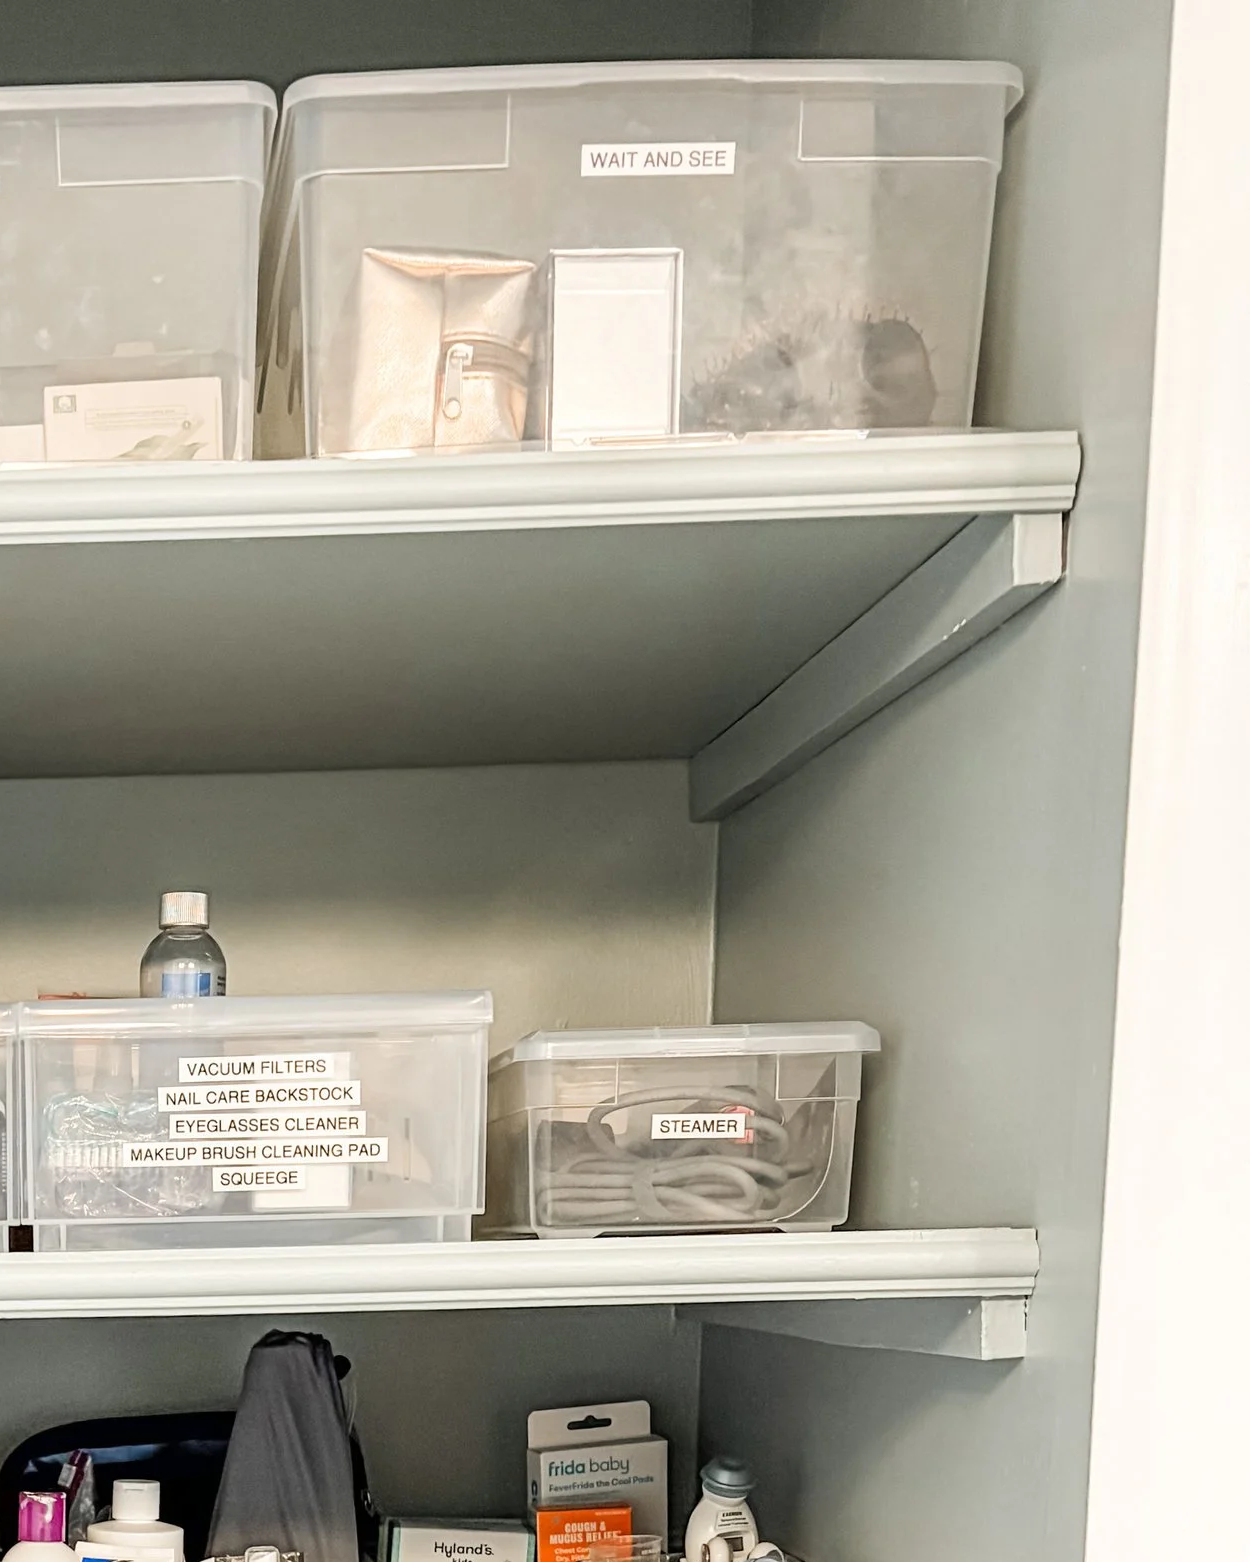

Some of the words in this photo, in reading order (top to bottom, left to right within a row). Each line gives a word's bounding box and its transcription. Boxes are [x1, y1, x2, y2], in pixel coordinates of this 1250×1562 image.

[590, 151, 638, 168] WAIT
[642, 150, 683, 168] AND
[688, 150, 726, 167] SEE
[187, 1061, 255, 1076] VACUUM
[261, 1060, 326, 1075] FILTERS
[166, 1090, 200, 1105] NAIL
[206, 1089, 249, 1104] CARE
[255, 1087, 353, 1102] BACKSTOCK
[175, 1119, 279, 1133] EYEGLASSES
[285, 1117, 359, 1131] CLEANER
[660, 1120, 738, 1133] STEAMER
[130, 1146, 196, 1161] MAKEUP
[202, 1145, 256, 1160] BRUSH
[262, 1144, 342, 1159] CLEANING
[349, 1143, 381, 1157] PAD
[221, 1171, 298, 1186] SQUEEGE
[549, 1461, 586, 1476] frida
[590, 1456, 629, 1474] baby
[549, 1481, 594, 1492] FeverFrida
[611, 1477, 631, 1486] Cool
[633, 1476, 654, 1484] Pads
[565, 1522, 596, 1532] COUGH
[550, 1533, 583, 1544] MUCUS
[586, 1532, 618, 1542] RELIEF
[434, 1542, 494, 1557] Hyland's
